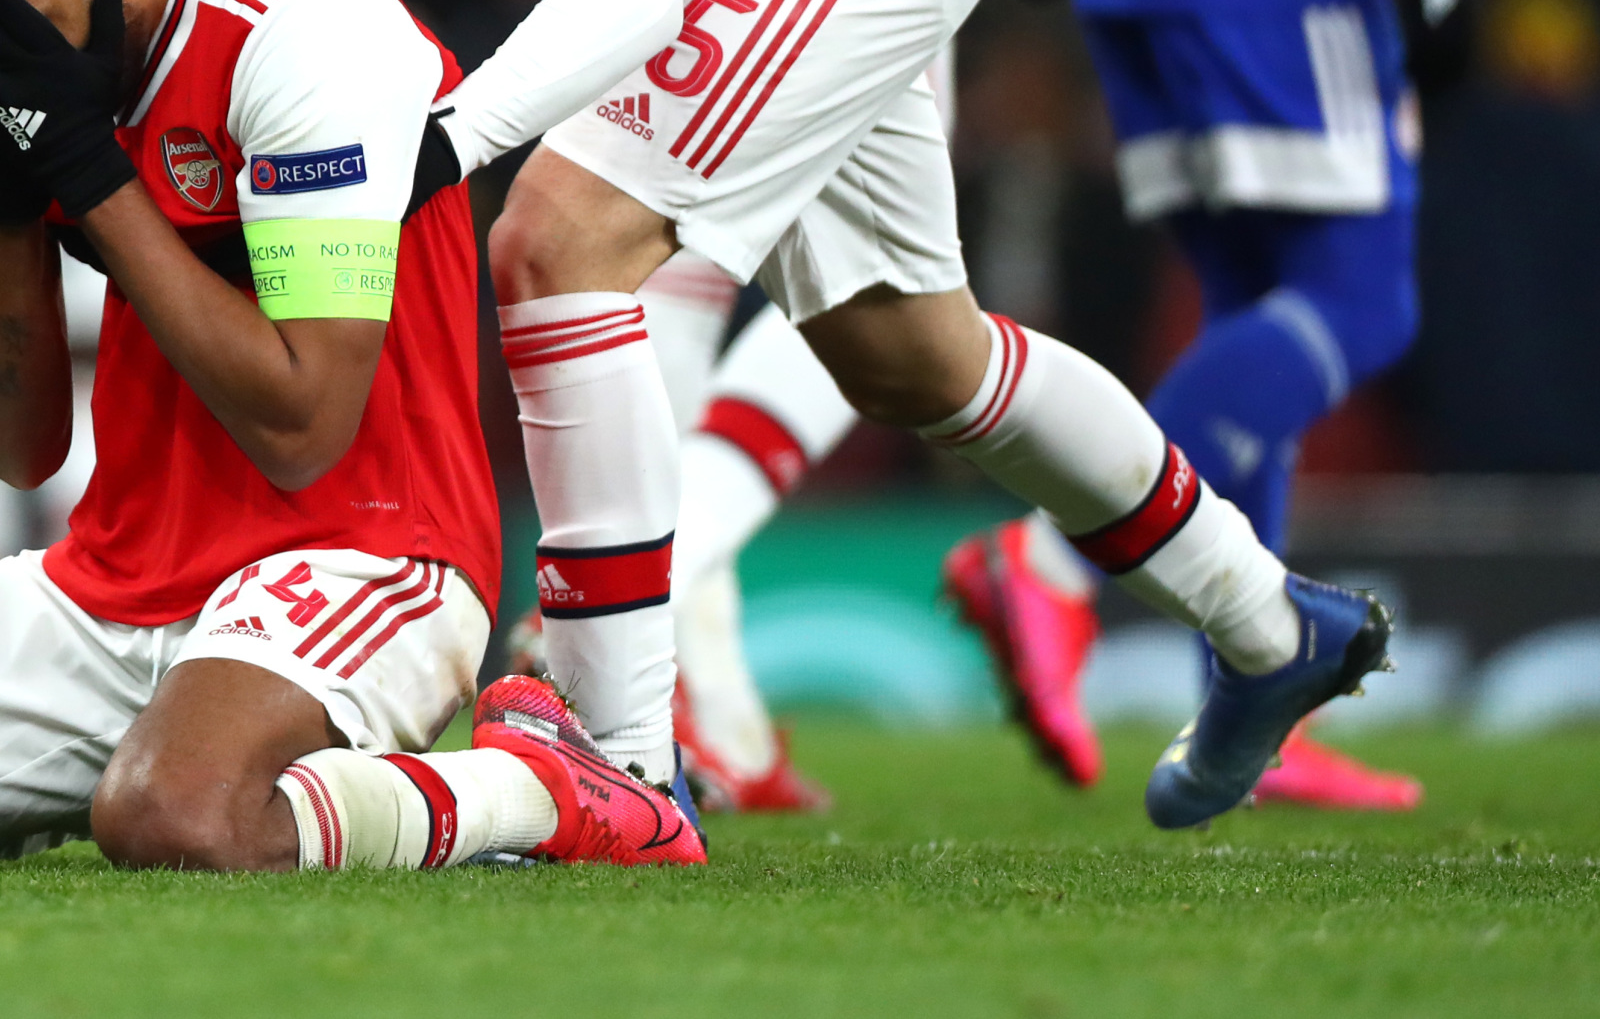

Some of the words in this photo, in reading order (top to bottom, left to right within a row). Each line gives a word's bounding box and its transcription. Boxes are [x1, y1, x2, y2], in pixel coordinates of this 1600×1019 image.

[597, 104, 654, 140] adidas
[169, 141, 209, 156] Arsenal
[279, 155, 363, 183] RESPECT
[321, 243, 349, 256] NO
[355, 244, 375, 257] TO
[208, 626, 272, 641] adidas
